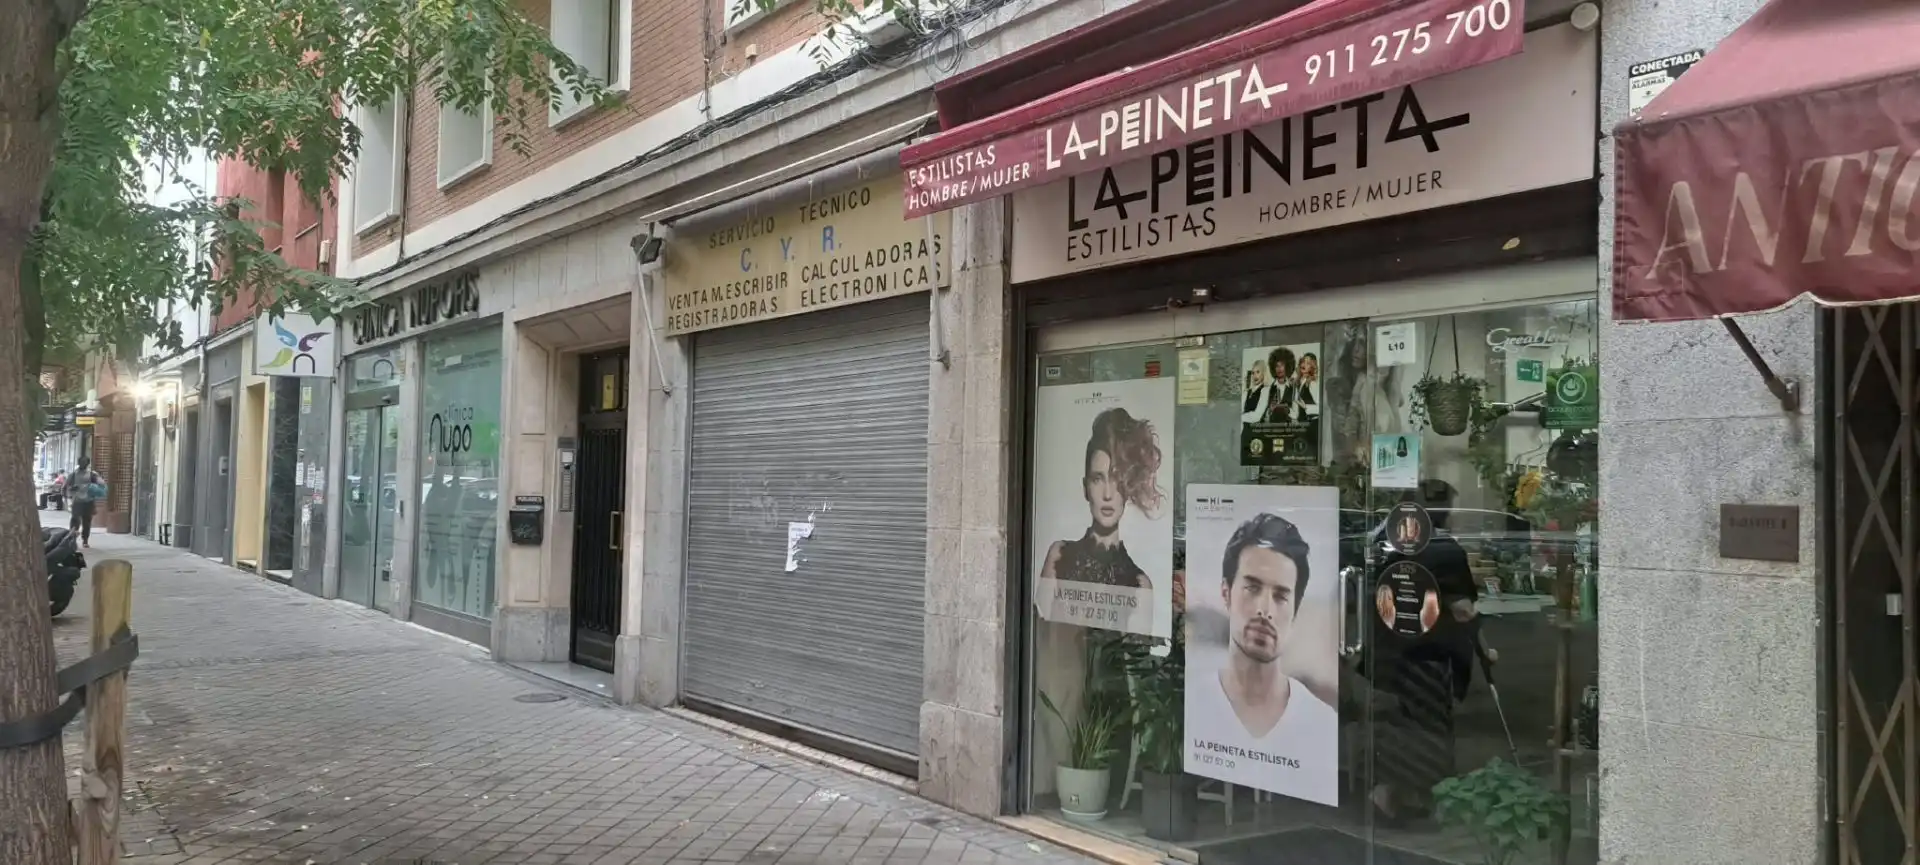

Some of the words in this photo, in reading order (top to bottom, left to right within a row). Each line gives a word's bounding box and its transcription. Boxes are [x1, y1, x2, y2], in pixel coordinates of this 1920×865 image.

[1100, 63, 1288, 157] PEINETA
[1305, 43, 1355, 85] 911
[1370, 22, 1430, 67] 275
[1446, 0, 1511, 45] 700
[1631, 51, 1701, 75] CONECTADA
[909, 145, 996, 188] ESTILISTAS
[709, 216, 775, 249] SERVICIO
[799, 187, 871, 223] TECNICO
[1067, 207, 1216, 261] ESTILISTAS
[801, 233, 942, 284] CALCULADORAS
[668, 296, 778, 331] REGISTRADORAS
[1053, 587, 1063, 601] LA
[1064, 588, 1094, 602] PEINETA
[1094, 590, 1138, 609] ESTILISTAS
[1194, 738, 1206, 749] LA
[1207, 741, 1246, 758] PEINETA
[1248, 749, 1301, 770] ESTILISTAS
